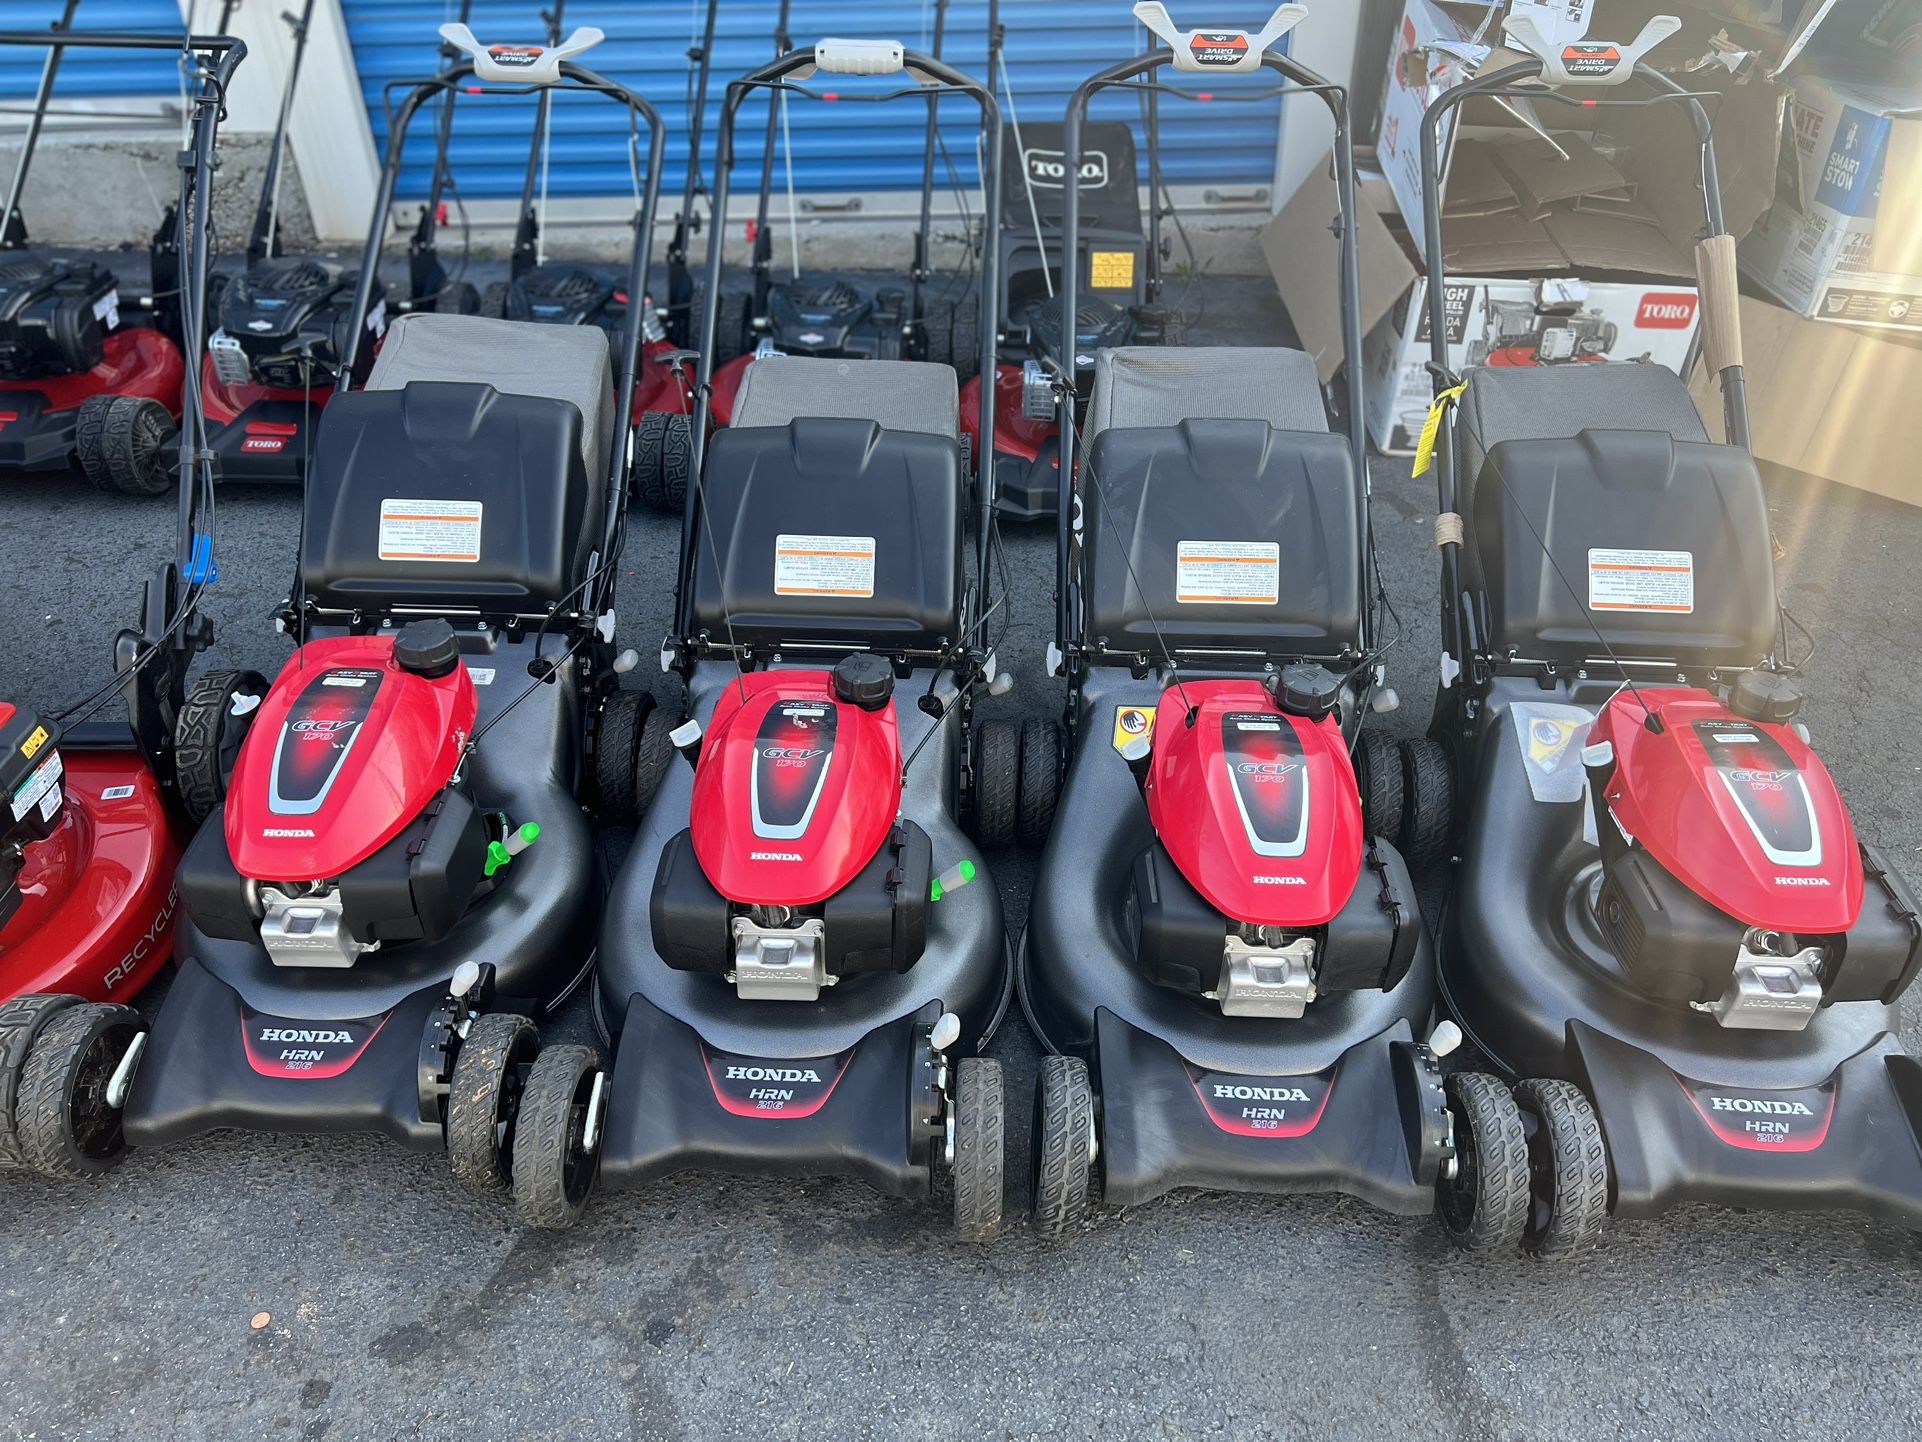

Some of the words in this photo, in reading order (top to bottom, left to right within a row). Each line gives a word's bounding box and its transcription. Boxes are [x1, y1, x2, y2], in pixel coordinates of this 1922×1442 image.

[1031, 160, 1103, 178] TOO
[1829, 152, 1860, 175] SMART
[1643, 304, 1690, 319] TORO
[247, 440, 281, 448] TORO
[292, 720, 356, 732] GCV
[303, 732, 334, 741] 170
[763, 747, 825, 760] GCV
[1237, 762, 1299, 774] GCV
[1254, 774, 1285, 783] 170
[1730, 770, 1792, 783] GCV
[1750, 782, 1783, 791] 170
[262, 829, 316, 837] HONDA
[750, 852, 803, 861] HONDA
[1252, 876, 1307, 885] HONDA
[1774, 877, 1831, 886] HONDA
[741, 970, 808, 980] HONDA
[1235, 989, 1302, 999] HONDA
[260, 1028, 354, 1043] HONDA
[279, 1049, 325, 1061] HRN
[285, 1061, 314, 1070] 216
[725, 1066, 822, 1082] HONDA
[749, 1088, 794, 1100] HRN
[1213, 1084, 1311, 1101] HONDA
[756, 1100, 785, 1110] 216
[1710, 1097, 1813, 1115] HONDA
[1242, 1107, 1286, 1119] HRN
[1250, 1119, 1278, 1130] 216
[1745, 1120, 1790, 1133] HRN
[1756, 1132, 1785, 1143] 216
